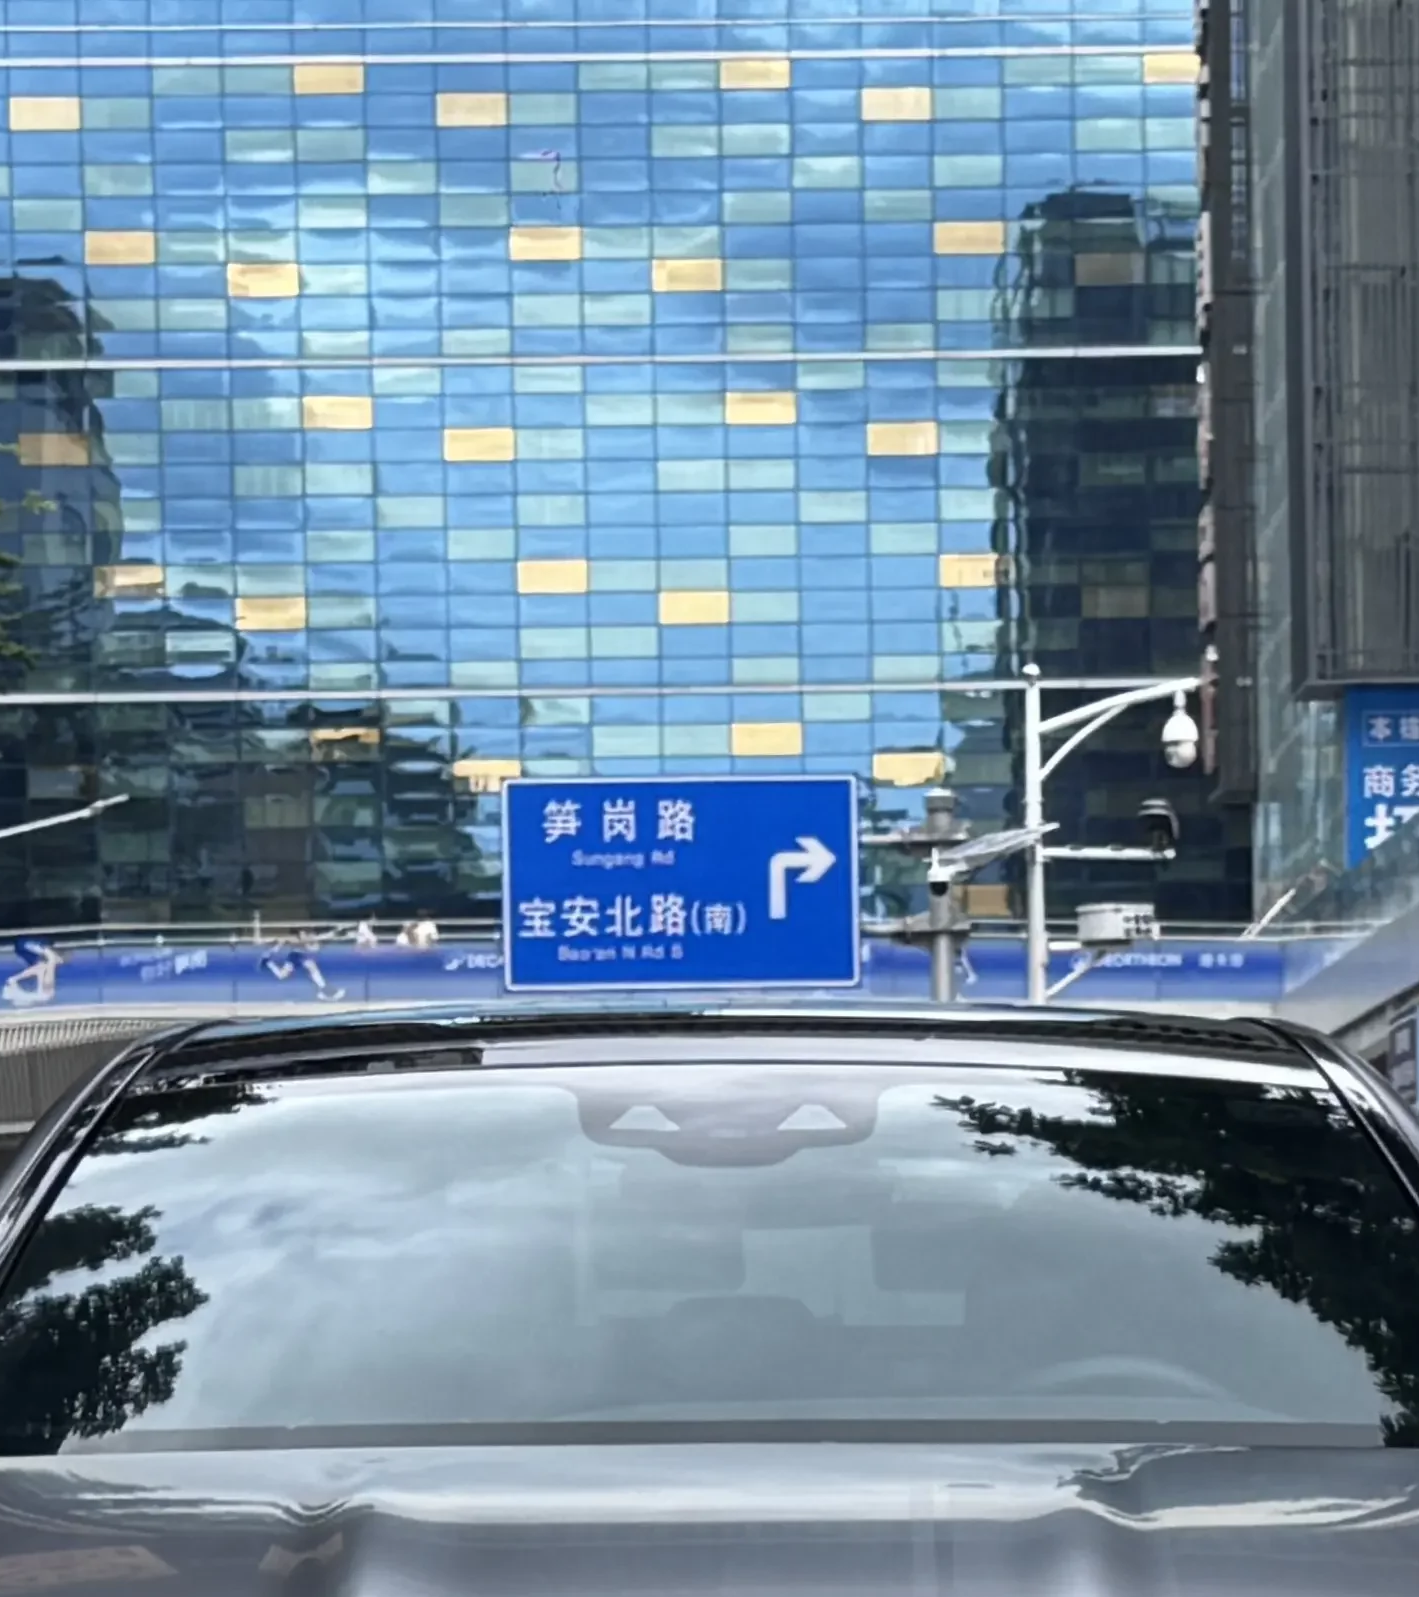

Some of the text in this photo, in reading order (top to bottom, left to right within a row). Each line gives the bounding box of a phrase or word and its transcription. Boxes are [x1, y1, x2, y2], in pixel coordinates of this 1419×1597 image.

[542, 798, 695, 843] 笋岗路
[572, 849, 675, 869] Sungang Rd
